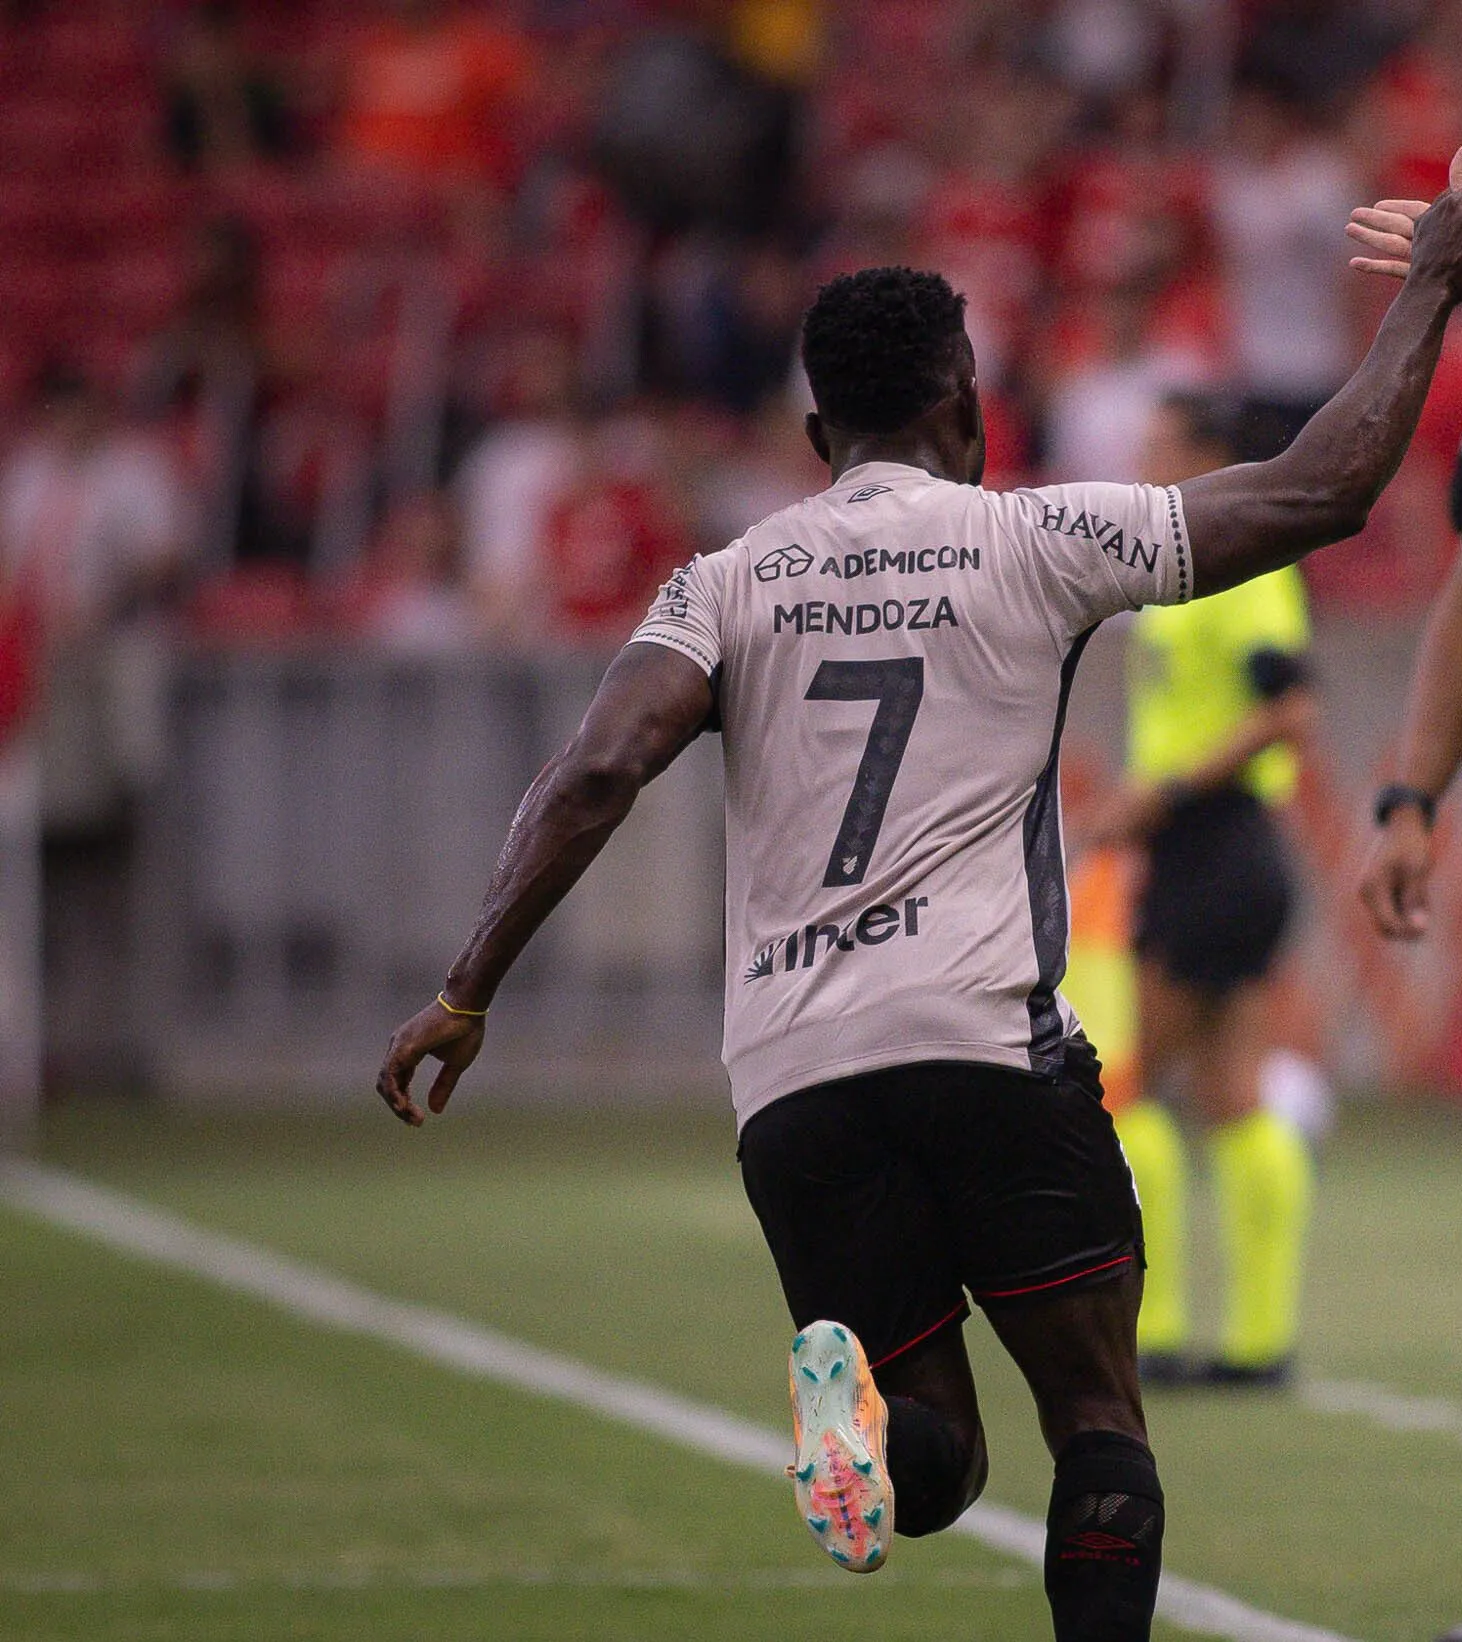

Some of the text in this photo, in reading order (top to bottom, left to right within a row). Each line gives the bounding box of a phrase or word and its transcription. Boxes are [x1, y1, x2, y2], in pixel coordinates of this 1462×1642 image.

[819, 545, 980, 579] ADEMICON
[1038, 504, 1162, 574] HAVAN
[774, 596, 959, 635] MENDOZA
[803, 656, 925, 888] 7
